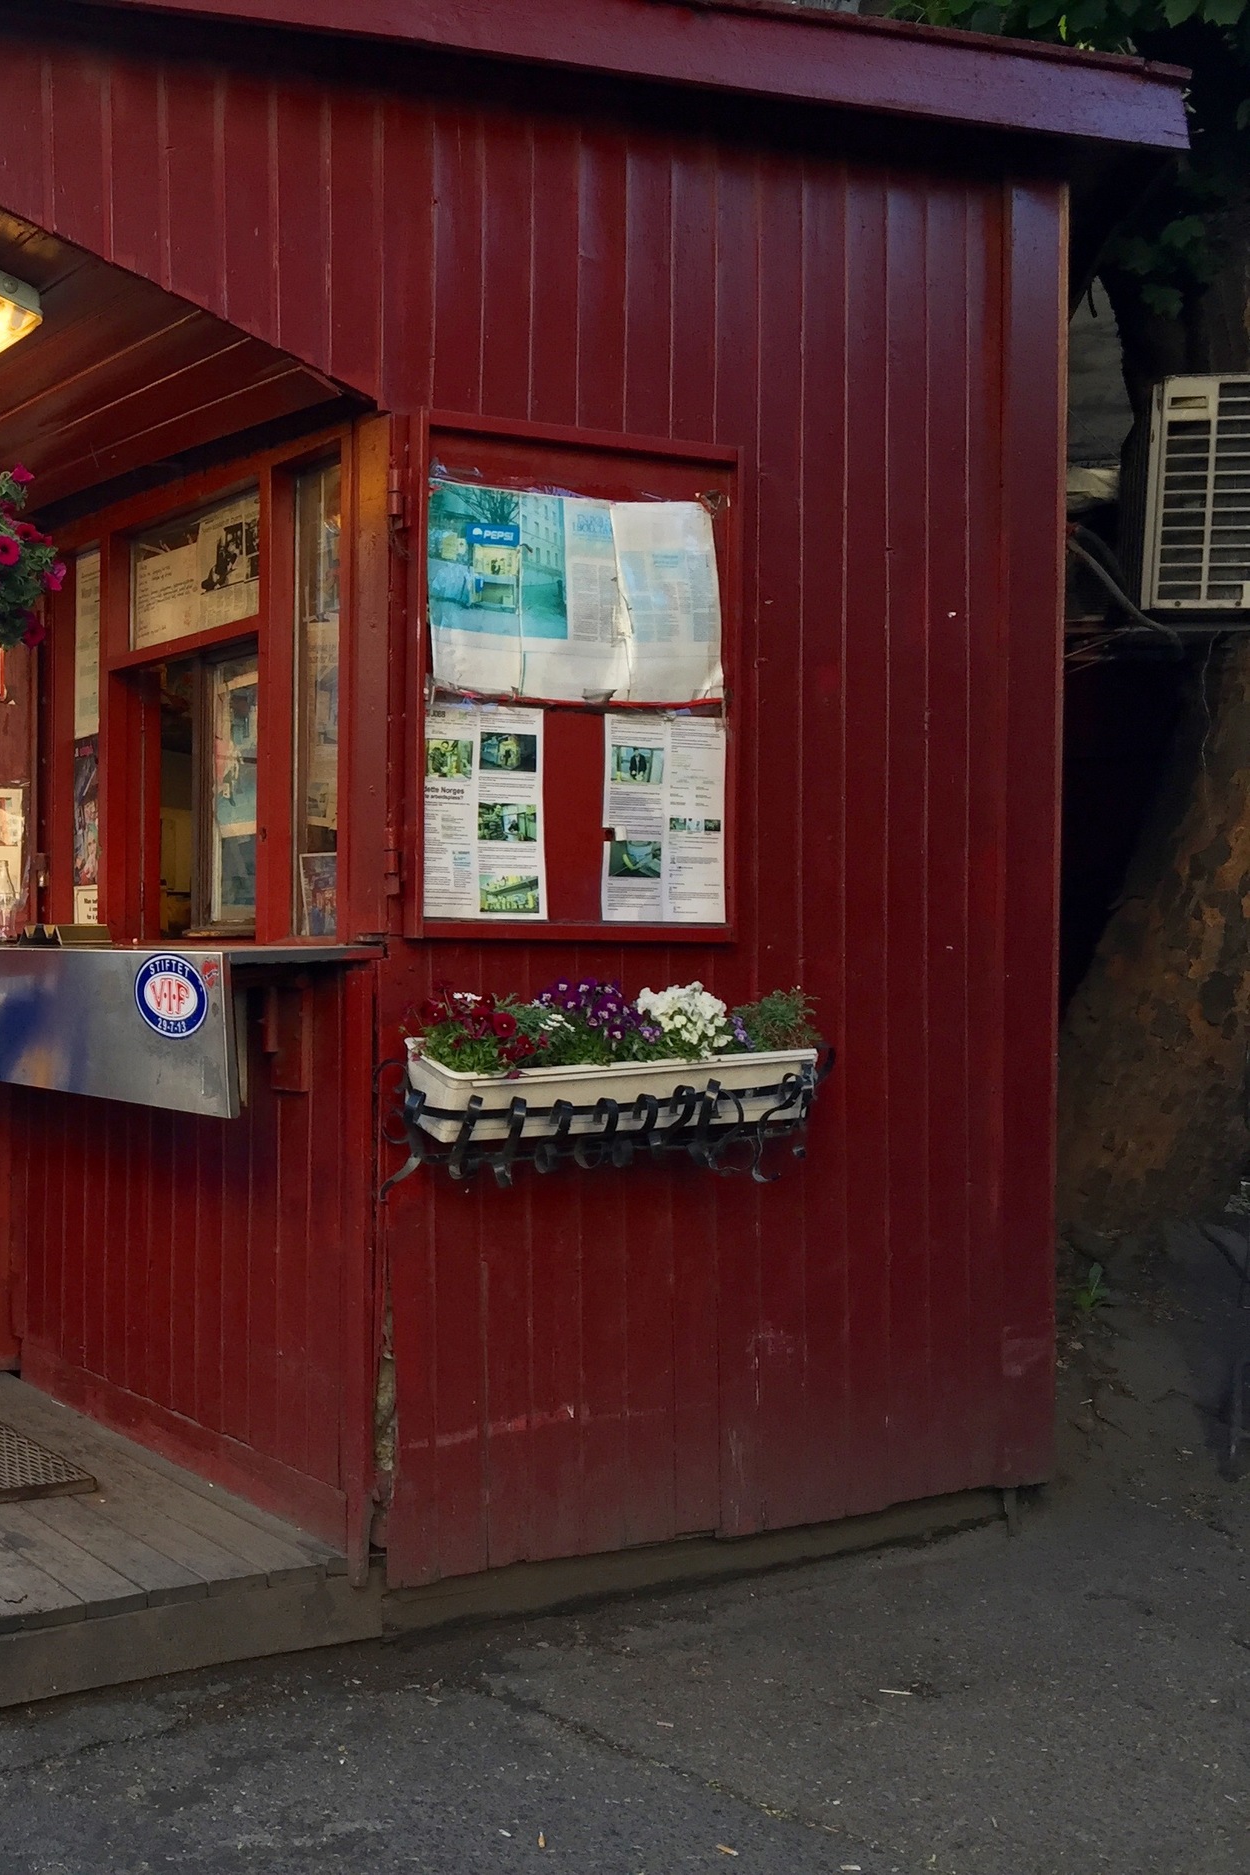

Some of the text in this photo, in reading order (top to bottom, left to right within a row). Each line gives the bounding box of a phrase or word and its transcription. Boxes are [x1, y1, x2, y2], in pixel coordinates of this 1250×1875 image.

[483, 530, 514, 541] PEPSI
[440, 786, 465, 796] Norges
[149, 960, 190, 977] STIFTET
